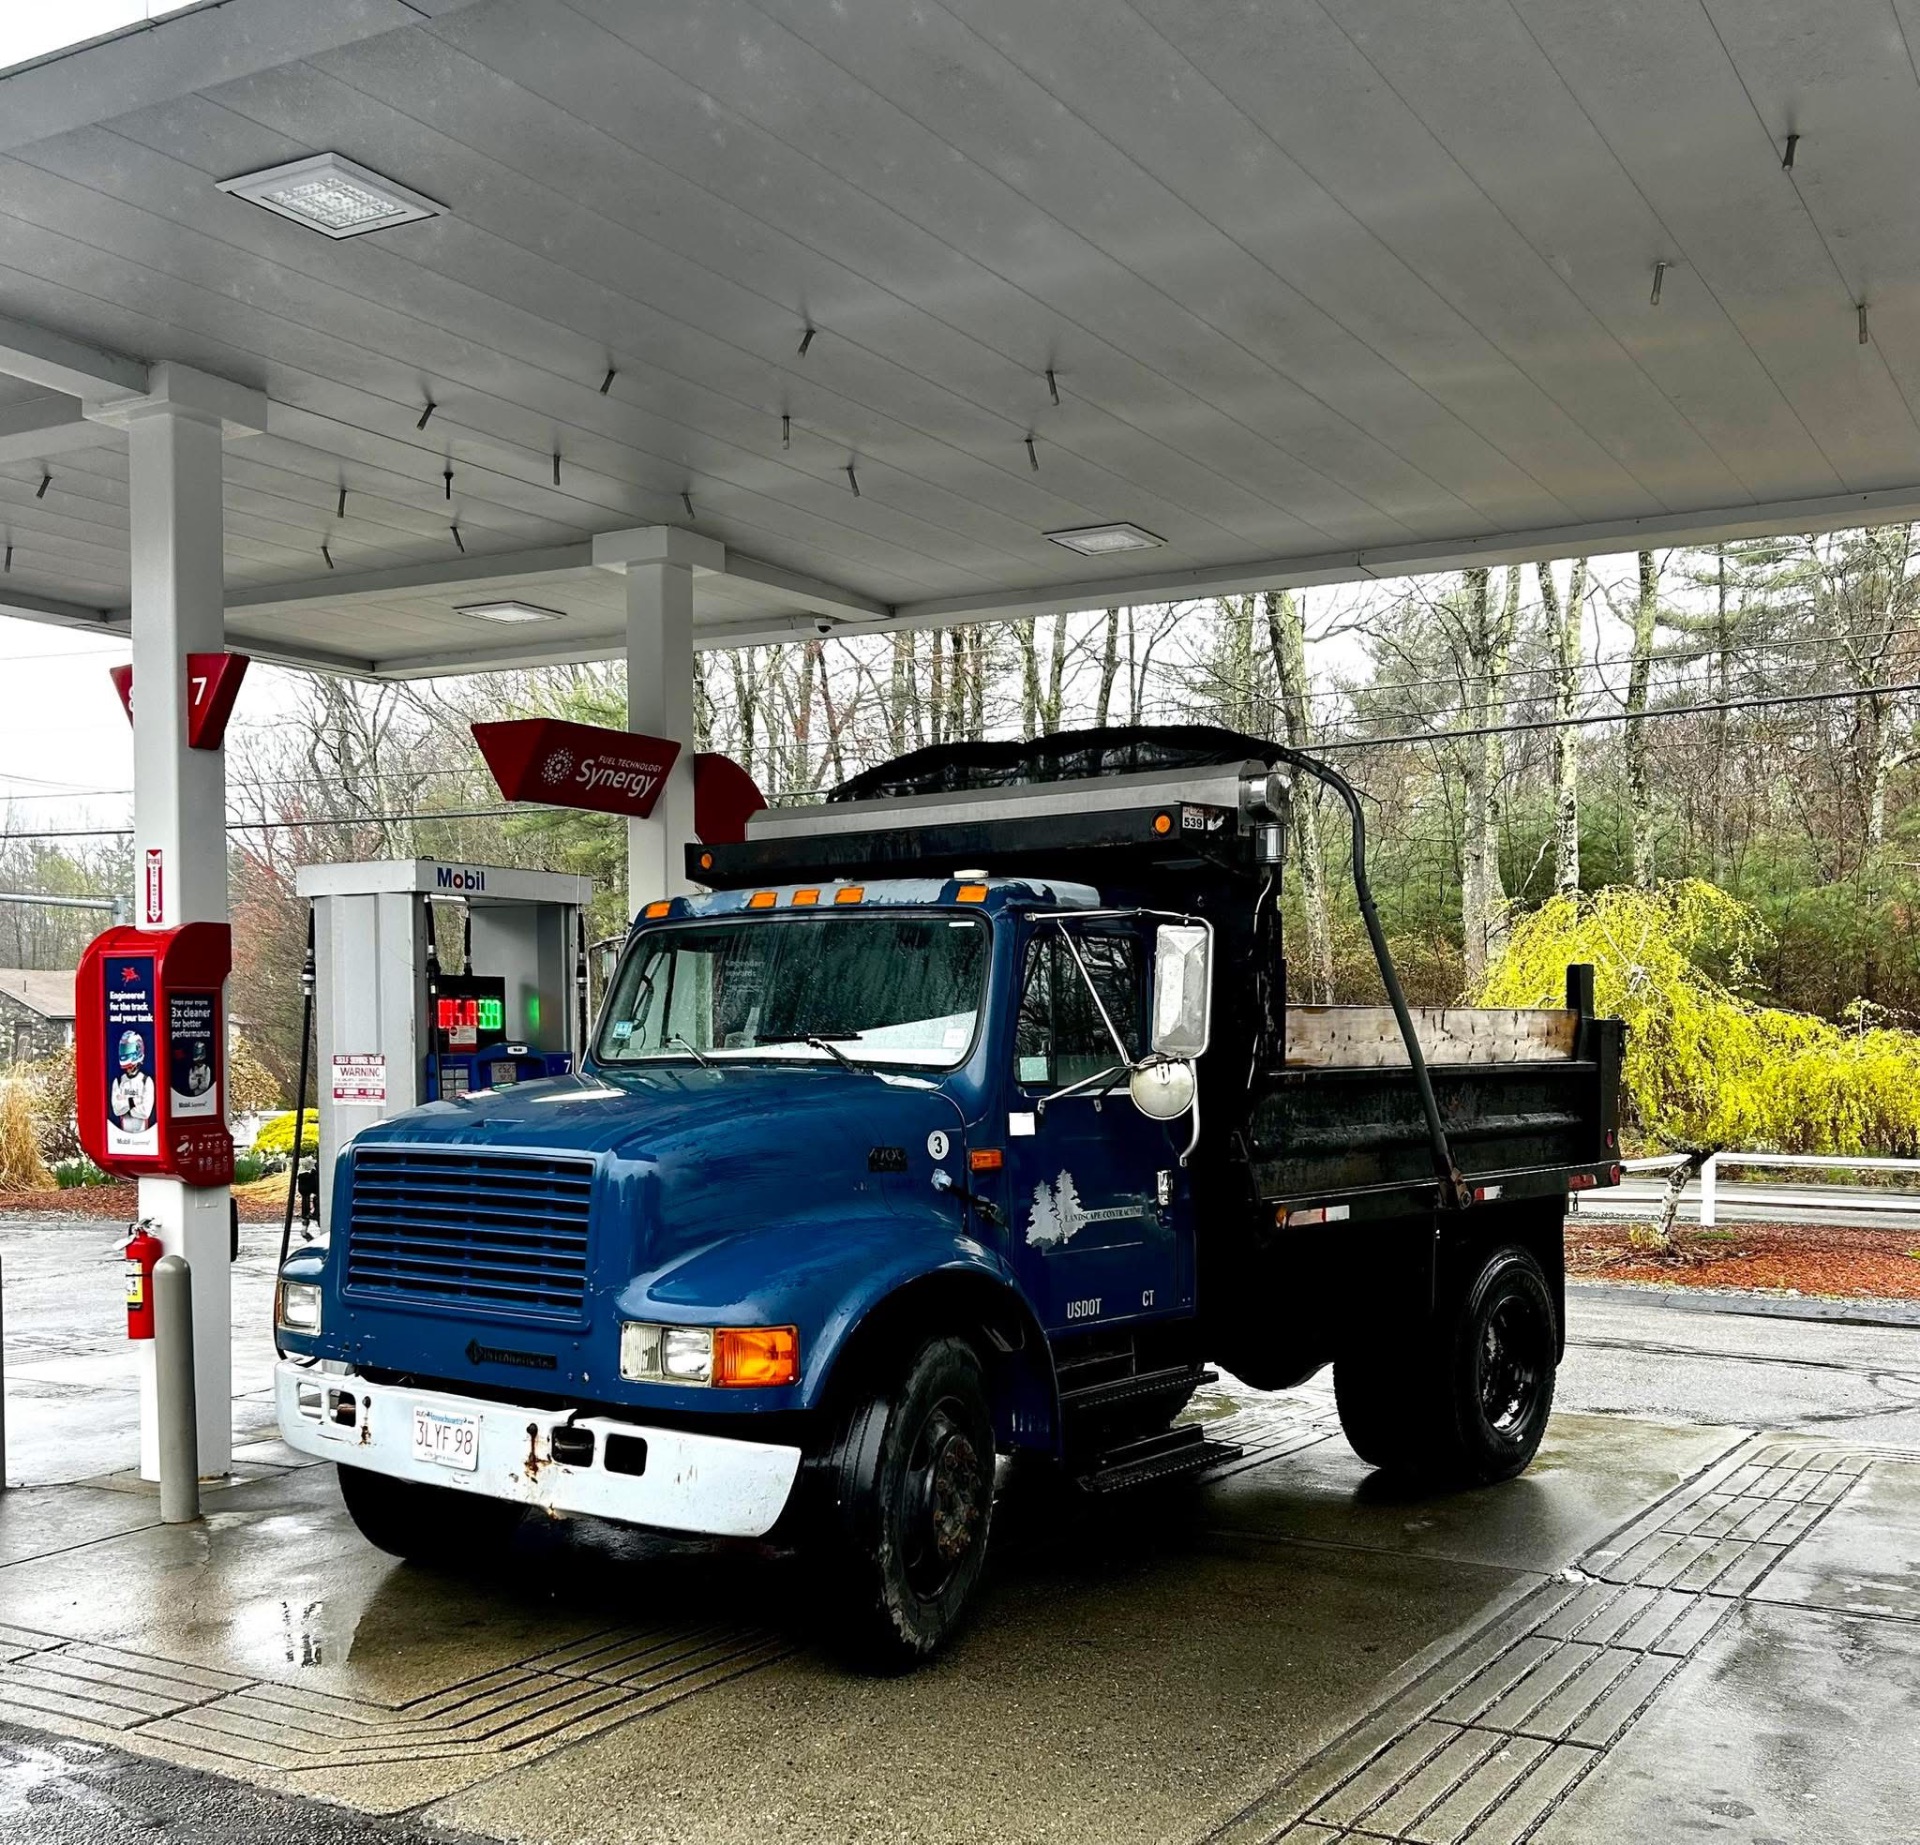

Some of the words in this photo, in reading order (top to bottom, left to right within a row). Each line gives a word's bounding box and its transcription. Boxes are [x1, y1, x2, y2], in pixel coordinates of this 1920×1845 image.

[192, 677, 207, 705] 7
[599, 755, 615, 766] FUEL
[618, 758, 662, 773] TECHNOLOGY
[575, 759, 658, 798] Synergy
[1184, 817, 1202, 828] 539
[437, 867, 485, 891] Mobil
[109, 991, 146, 1001] Engineered
[109, 1002, 119, 1010] for
[120, 1002, 131, 1010] the
[131, 1002, 149, 1011] track
[171, 1007, 182, 1017] 3x
[183, 1007, 211, 1017] cleaner
[110, 1013, 122, 1022] and
[122, 1015, 137, 1024] your
[138, 1013, 153, 1022] tank
[171, 1019, 182, 1027] for
[182, 1019, 202, 1027] better
[171, 1029, 211, 1039] performance
[564, 1060, 571, 1073] 7
[934, 1136, 943, 1154] 3
[1067, 1298, 1102, 1319] USDOT
[1142, 1289, 1154, 1306] CT
[416, 1420, 451, 1451] 3LYF
[454, 1428, 473, 1455] 98
